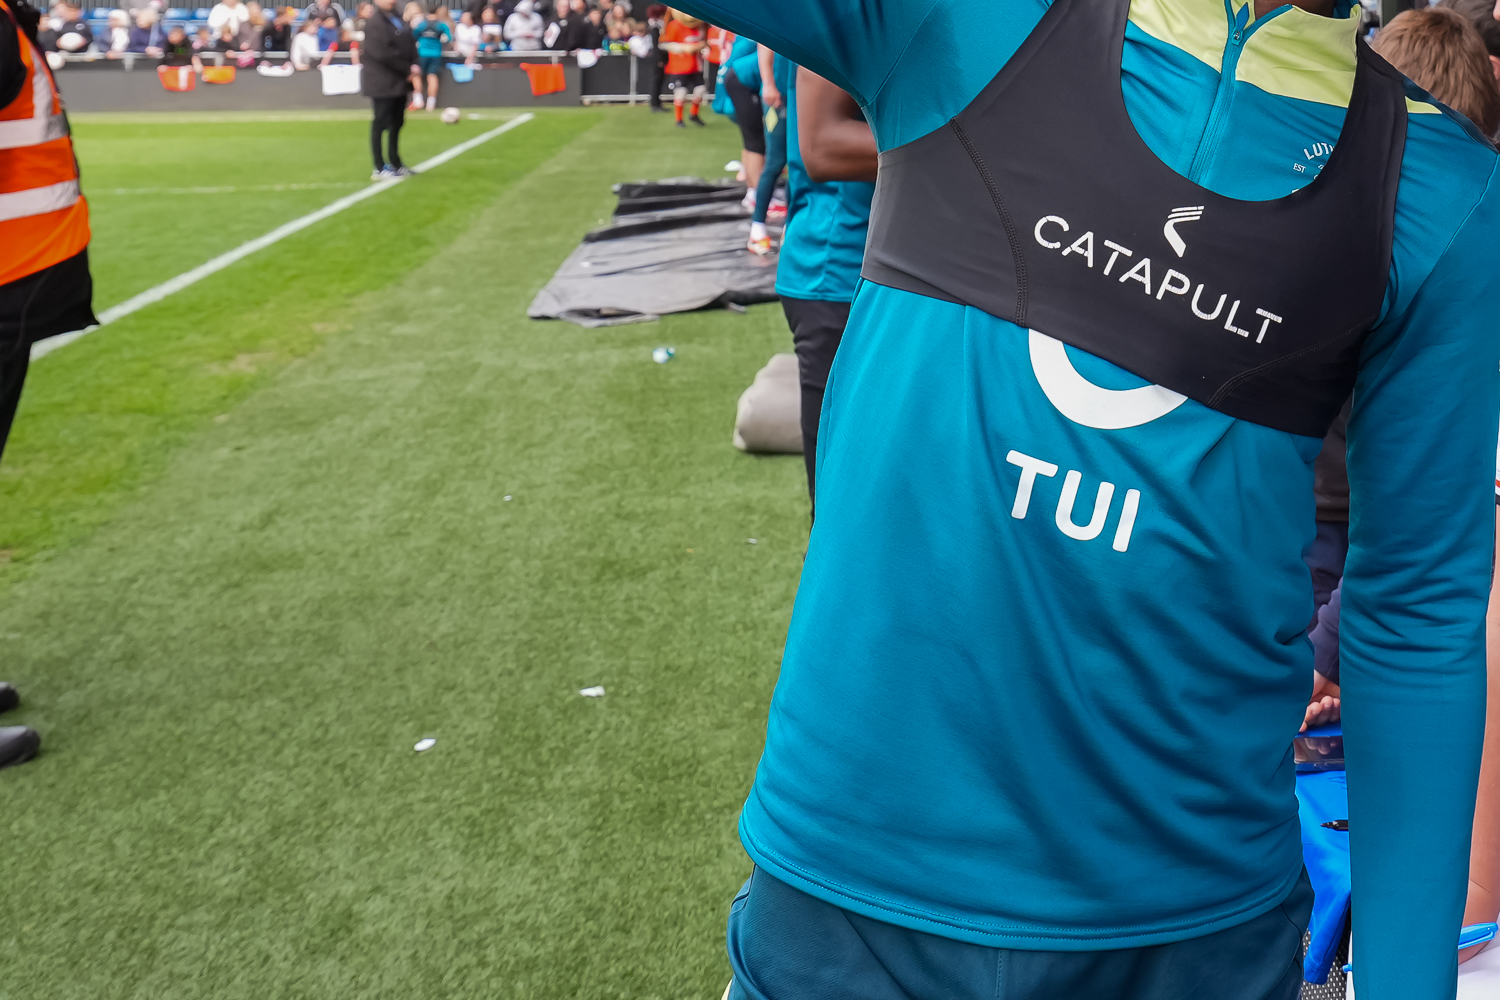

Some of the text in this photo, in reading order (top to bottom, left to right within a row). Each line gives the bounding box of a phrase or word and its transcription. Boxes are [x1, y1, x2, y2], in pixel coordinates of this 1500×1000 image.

[1292, 162, 1307, 174] EST
[1034, 215, 1283, 344] CATAPULT
[1005, 449, 1141, 553] TUI
